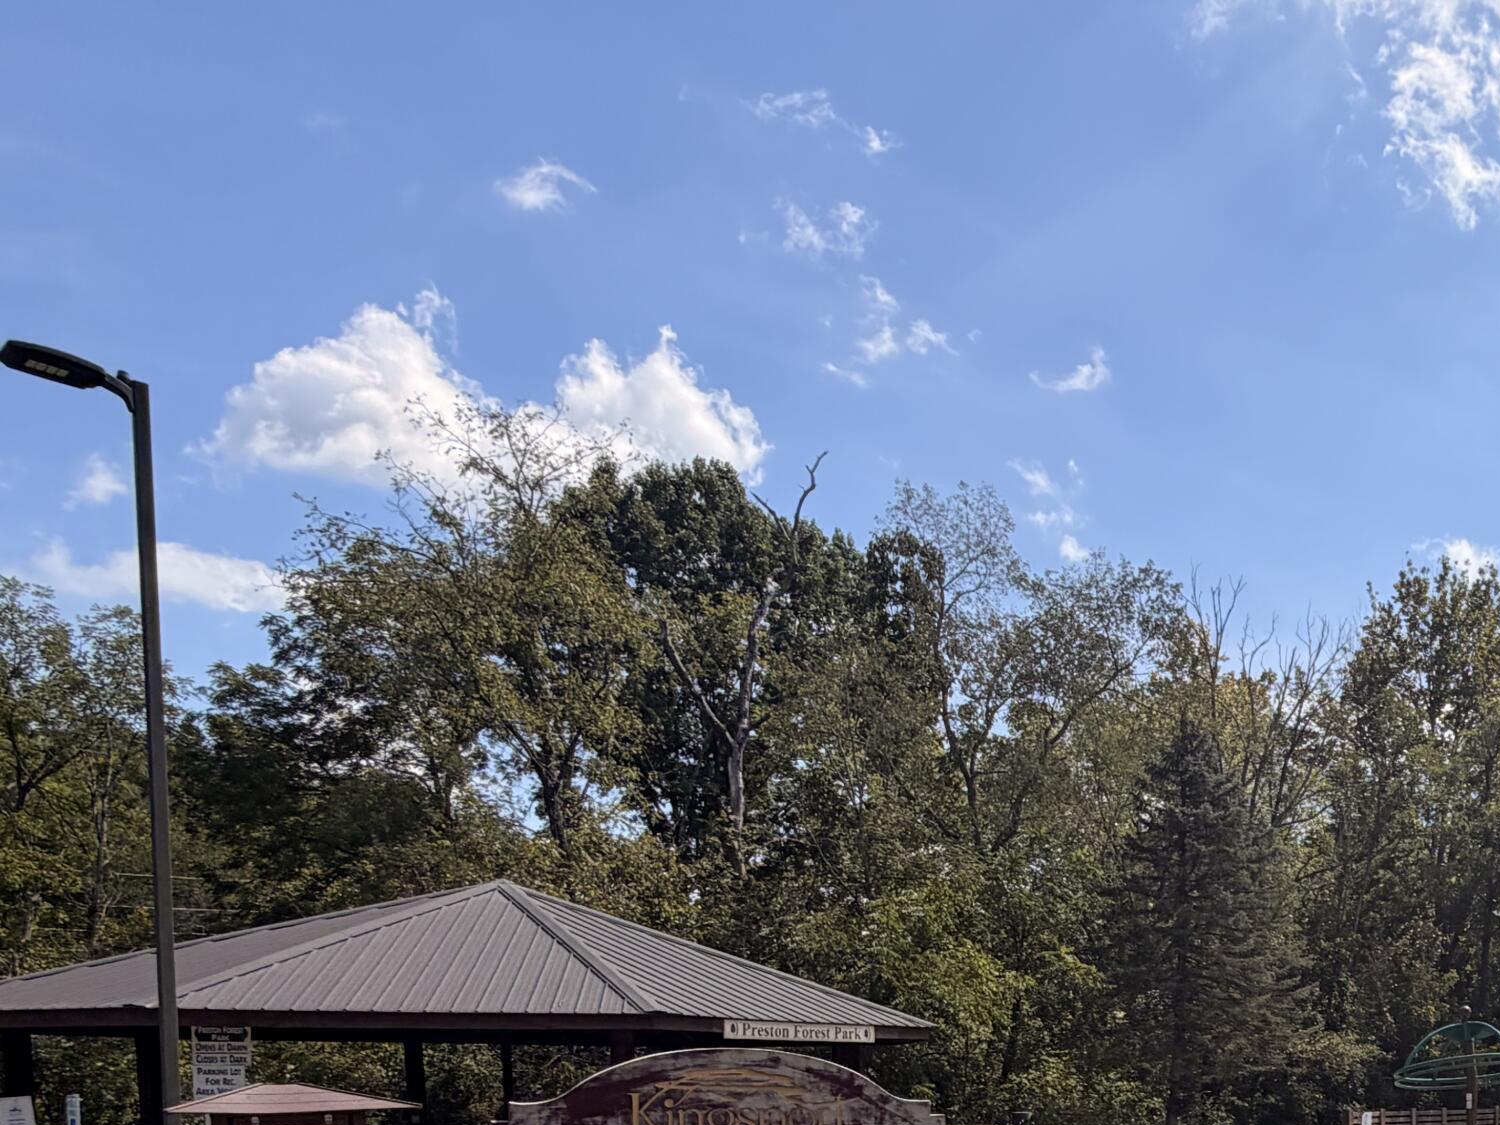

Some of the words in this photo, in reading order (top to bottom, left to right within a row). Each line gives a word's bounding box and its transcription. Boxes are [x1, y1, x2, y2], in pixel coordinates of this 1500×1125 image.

[742, 1022, 790, 1038] Preston
[794, 1024, 831, 1040] Forest
[834, 1026, 862, 1040] Park
